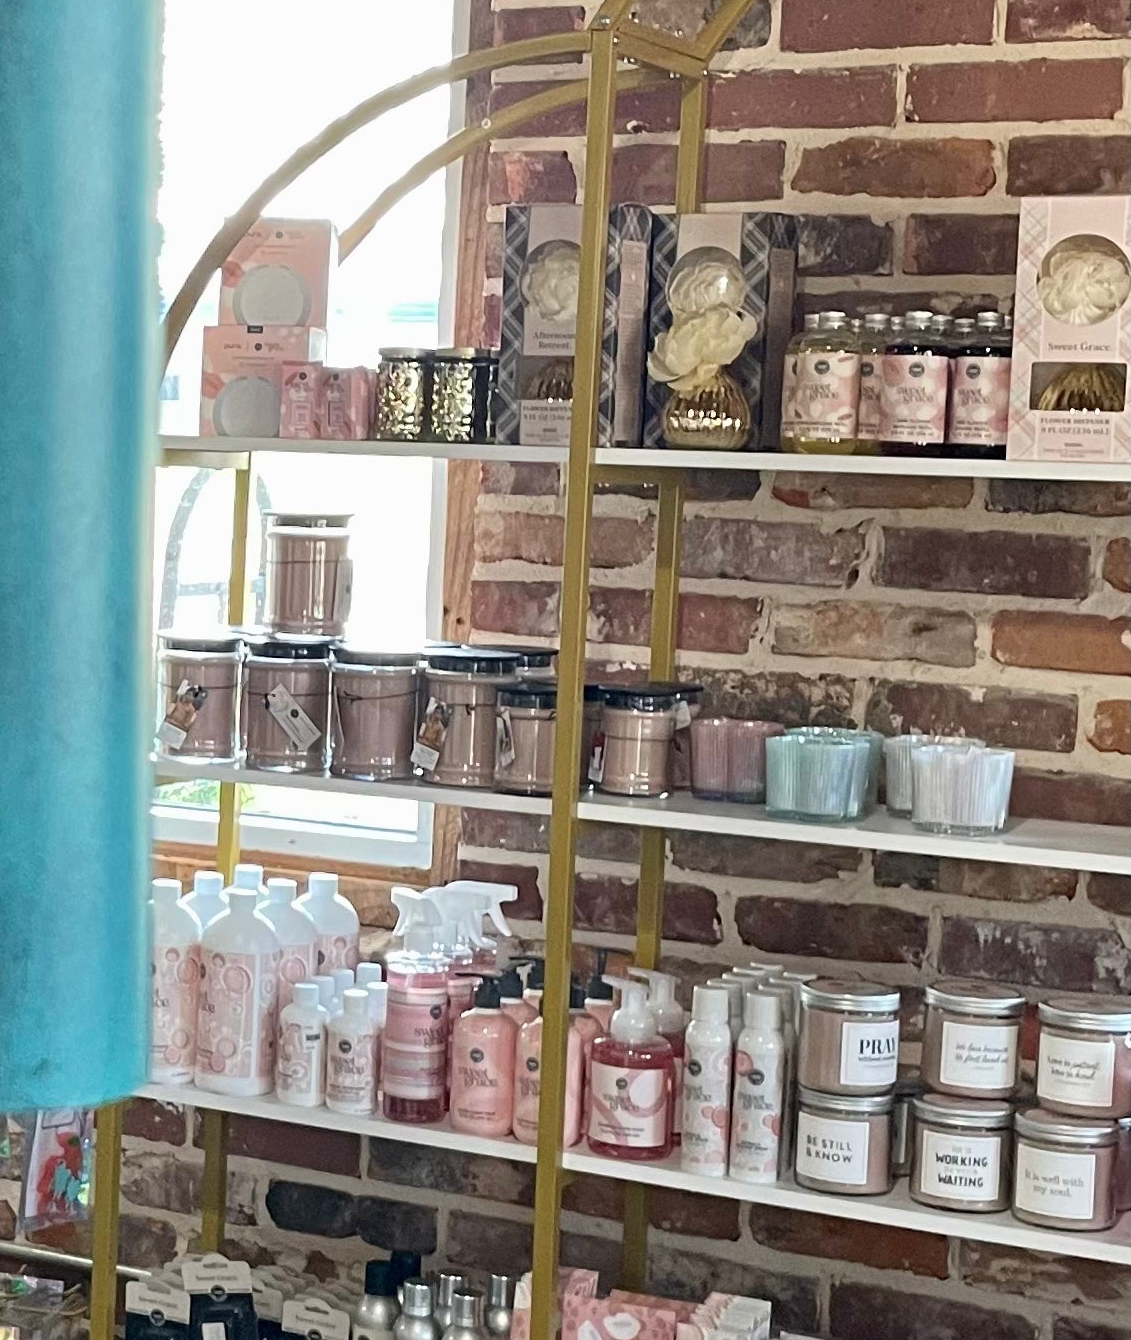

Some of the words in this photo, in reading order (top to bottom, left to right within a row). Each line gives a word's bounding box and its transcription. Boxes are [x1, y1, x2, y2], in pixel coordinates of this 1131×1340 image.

[1048, 342, 1078, 351] Sweet
[1080, 341, 1111, 351] Grace
[821, 1138, 853, 1152] STILL
[815, 1149, 853, 1163] KNOW
[935, 1152, 988, 1168] WORKING
[937, 1173, 984, 1189] WAITING
